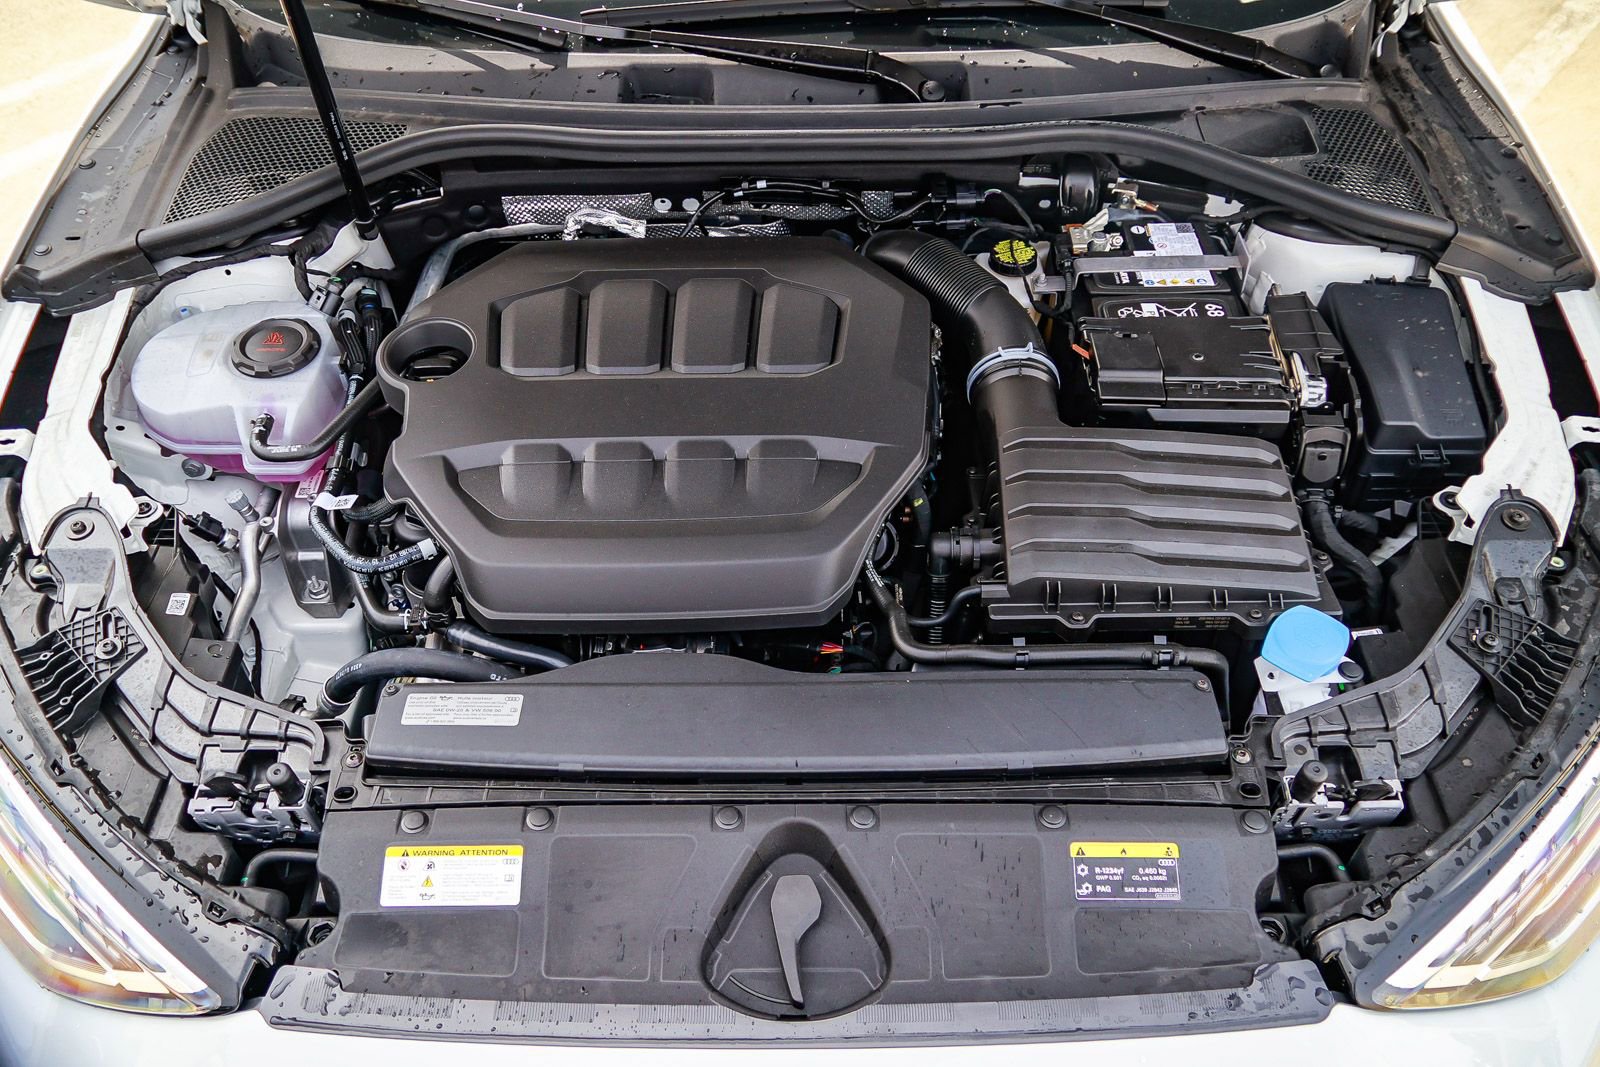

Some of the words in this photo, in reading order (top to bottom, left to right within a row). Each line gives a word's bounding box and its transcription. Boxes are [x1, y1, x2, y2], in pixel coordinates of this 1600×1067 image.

[1205, 304, 1224, 317] 68
[413, 849, 455, 857] WARNING
[1158, 868, 1166, 876] kg
[1096, 885, 1111, 893] PAG
